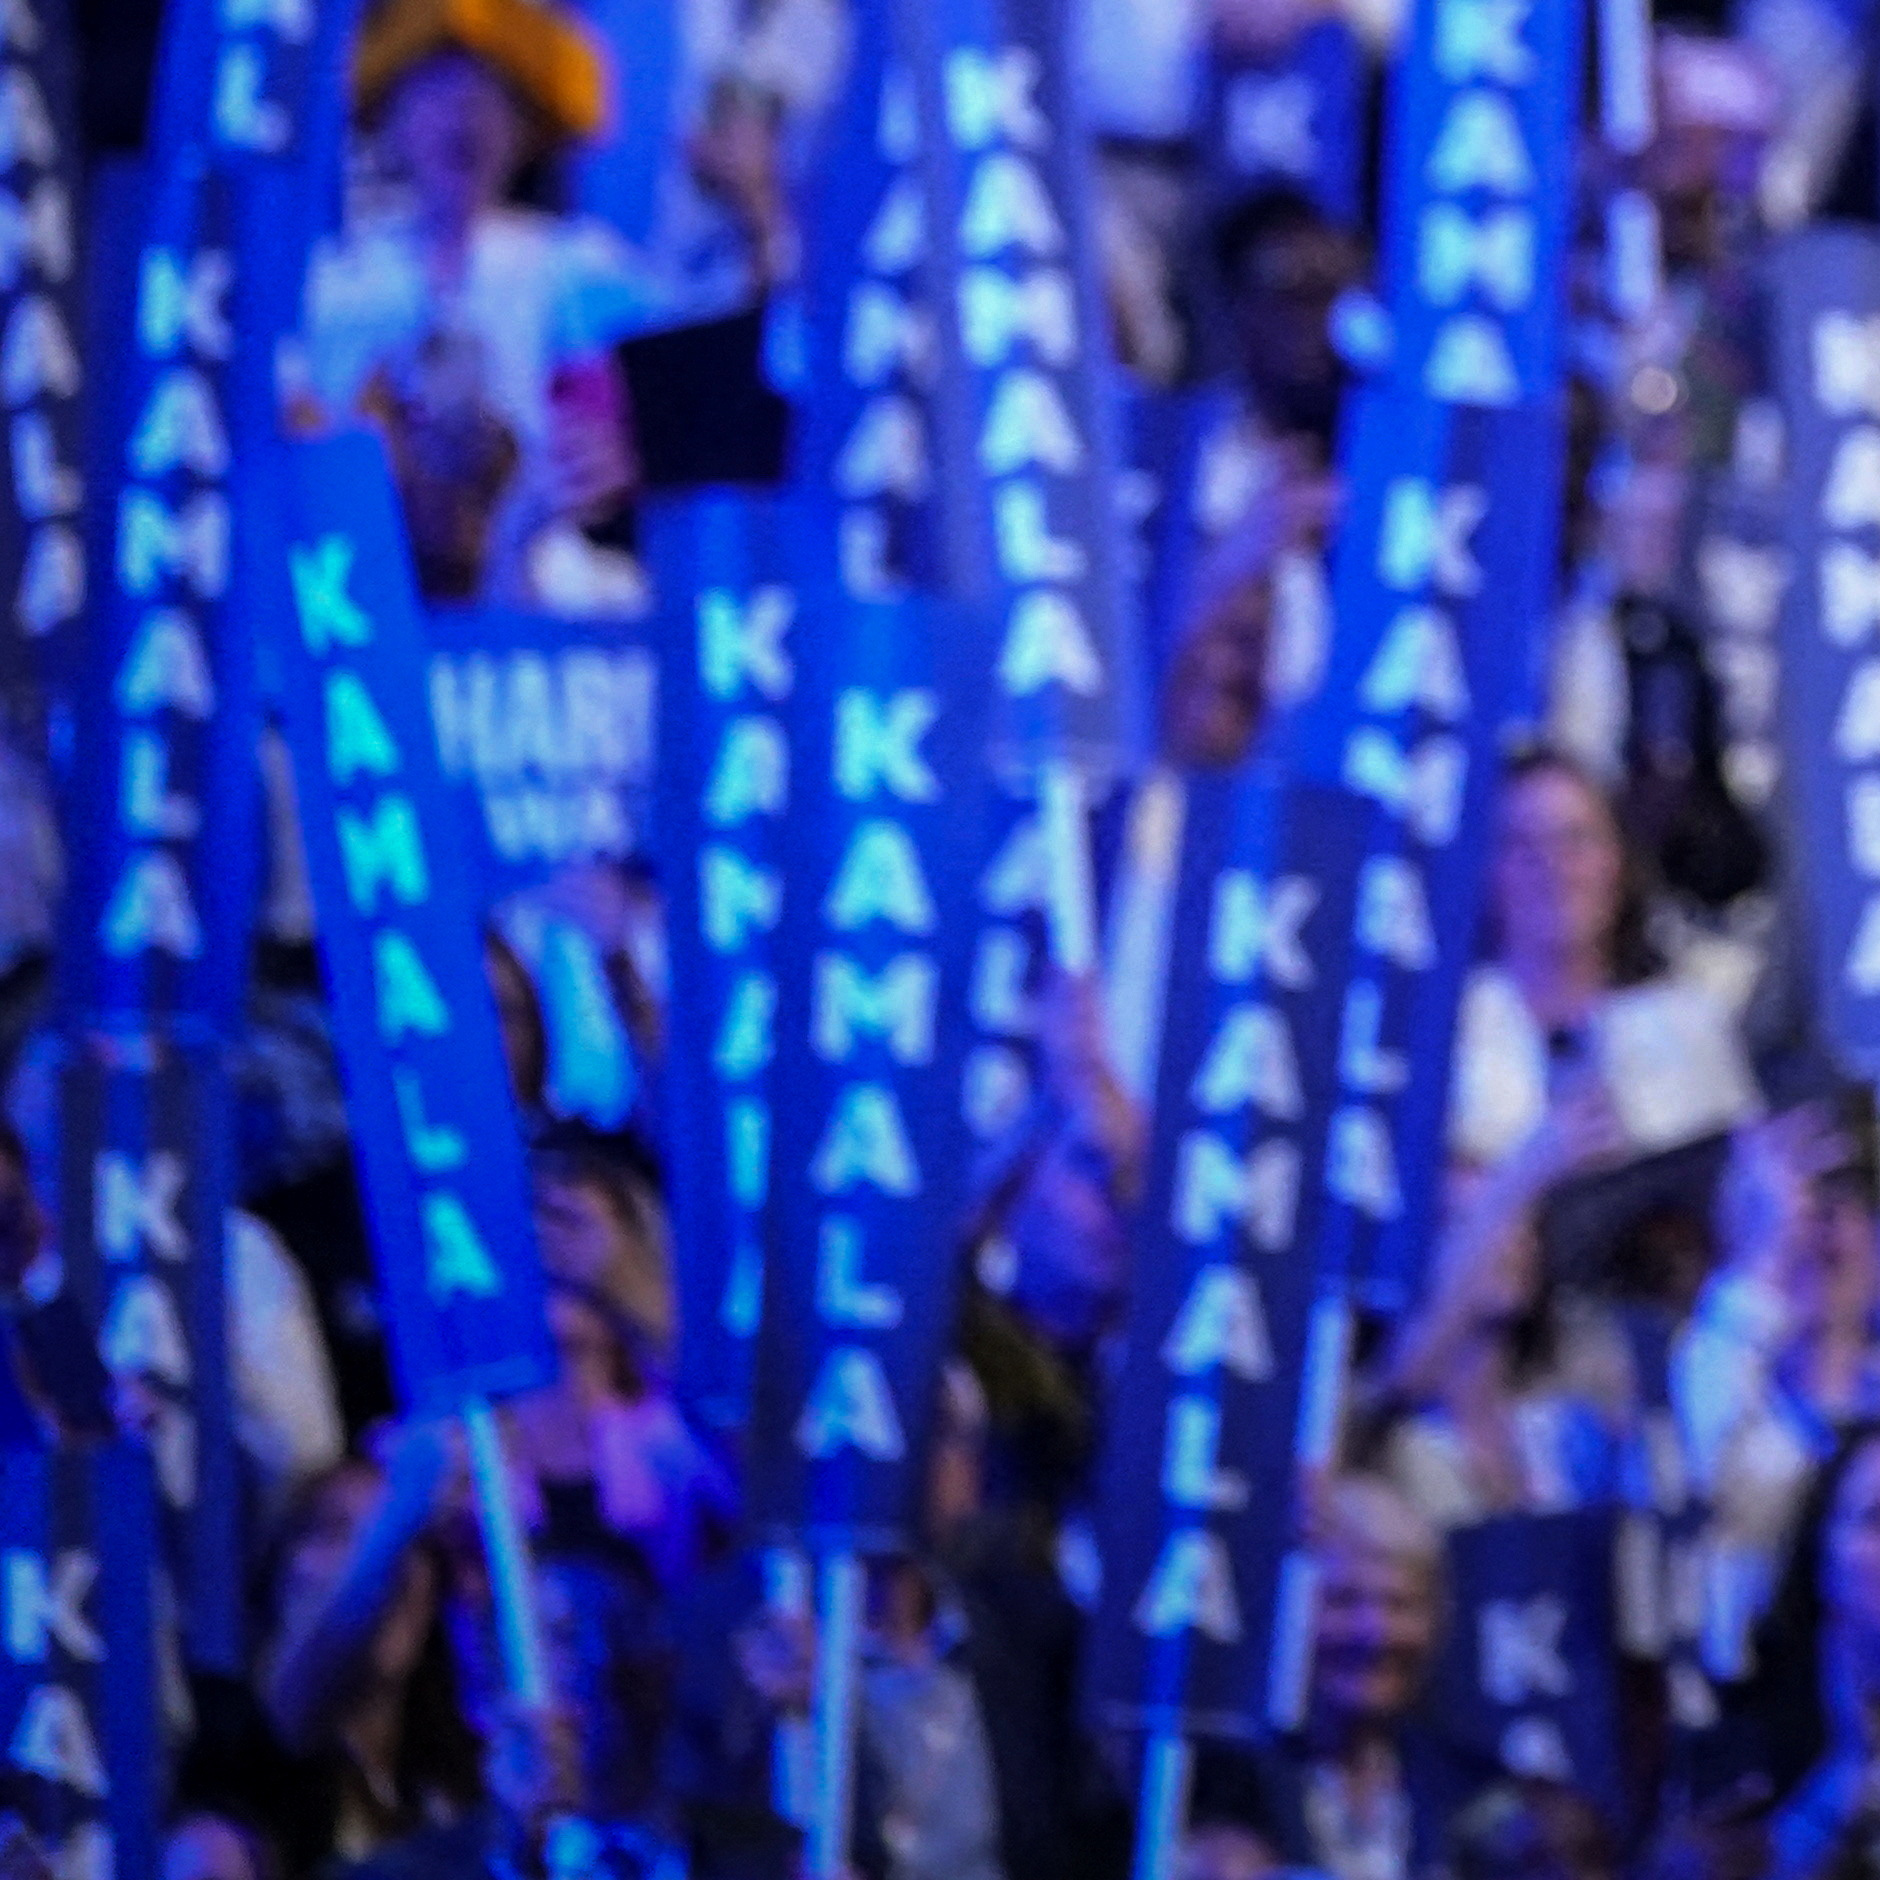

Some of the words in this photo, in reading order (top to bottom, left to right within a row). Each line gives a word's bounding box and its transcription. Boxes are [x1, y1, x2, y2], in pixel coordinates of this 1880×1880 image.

[105, 242, 238, 958] KAMALA
[950, 42, 1100, 697] KAMALA
[288, 530, 502, 1302] KAMALA
[808, 682, 946, 1462] KAMALA
[1130, 868, 1322, 1648] KAMALA
